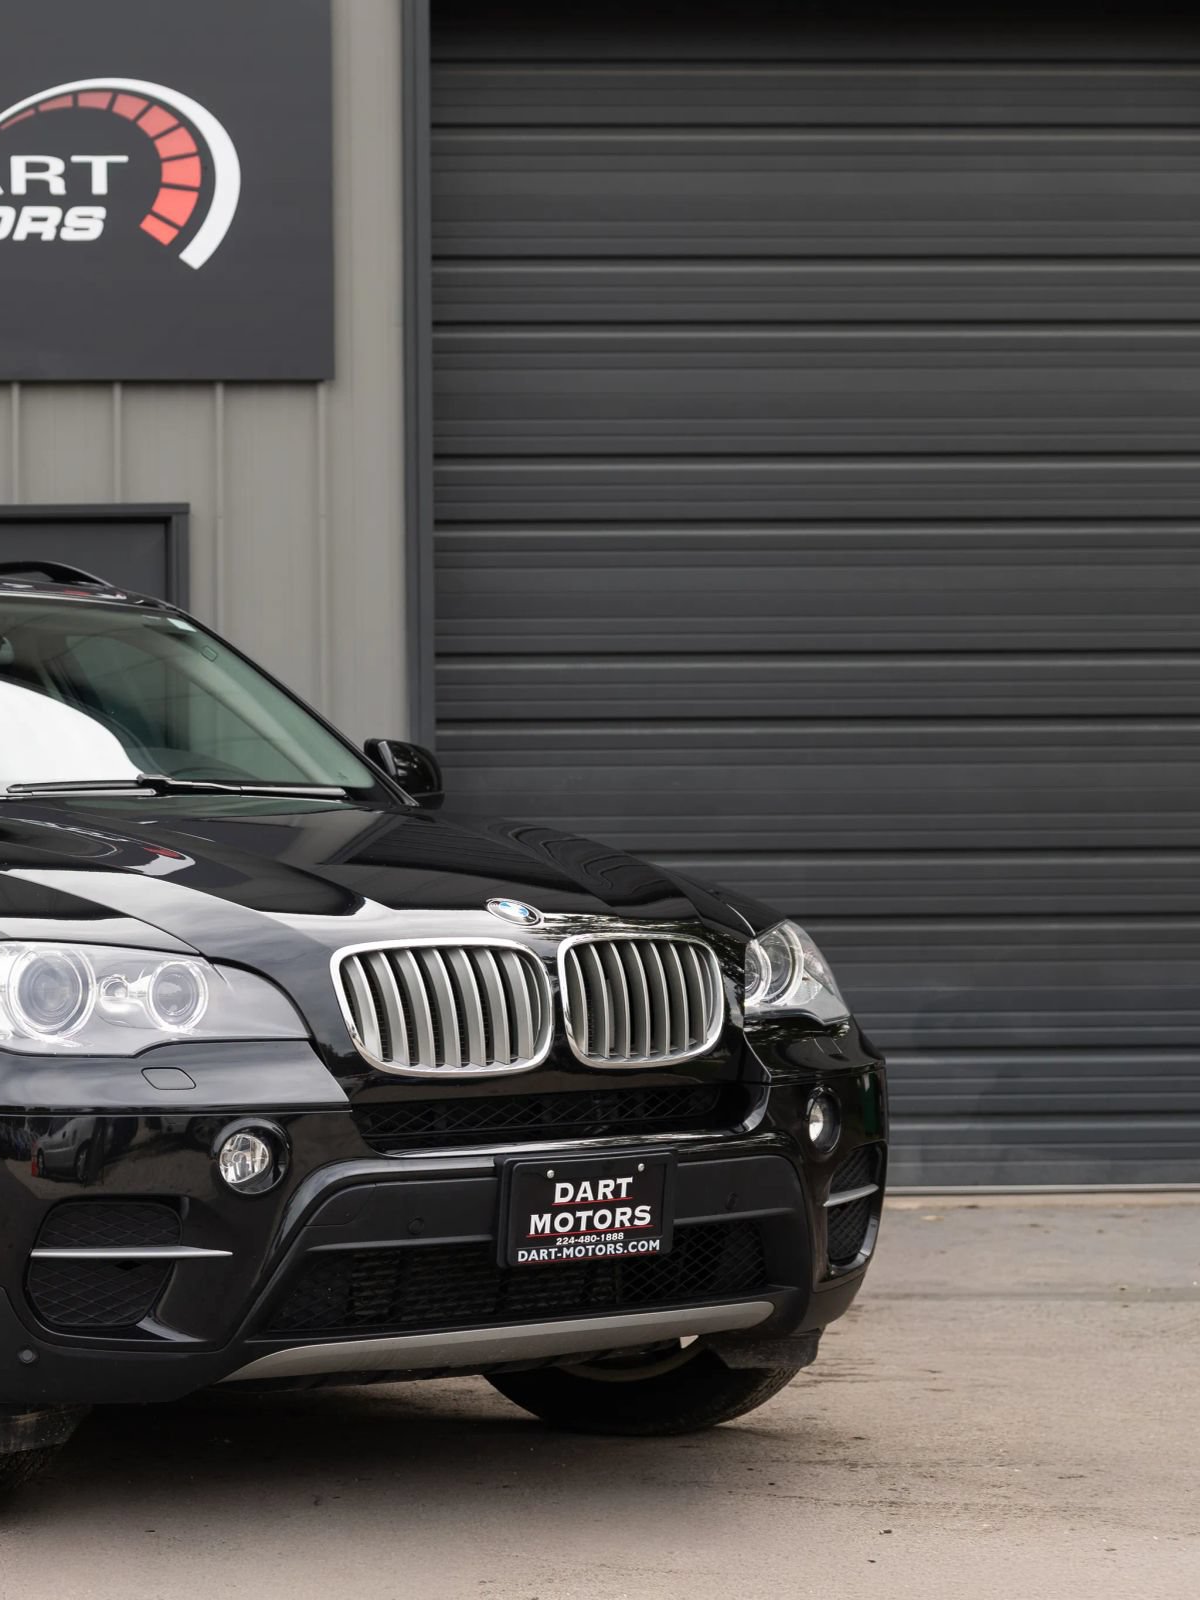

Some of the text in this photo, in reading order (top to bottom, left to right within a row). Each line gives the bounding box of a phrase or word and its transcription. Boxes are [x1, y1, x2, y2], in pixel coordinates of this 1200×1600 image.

[554, 1176, 633, 1204] DART
[529, 1205, 652, 1236] MOTORS
[518, 1239, 660, 1262] DART-MOTORS.COM
[556, 1232, 624, 1246] 224-480-1888
